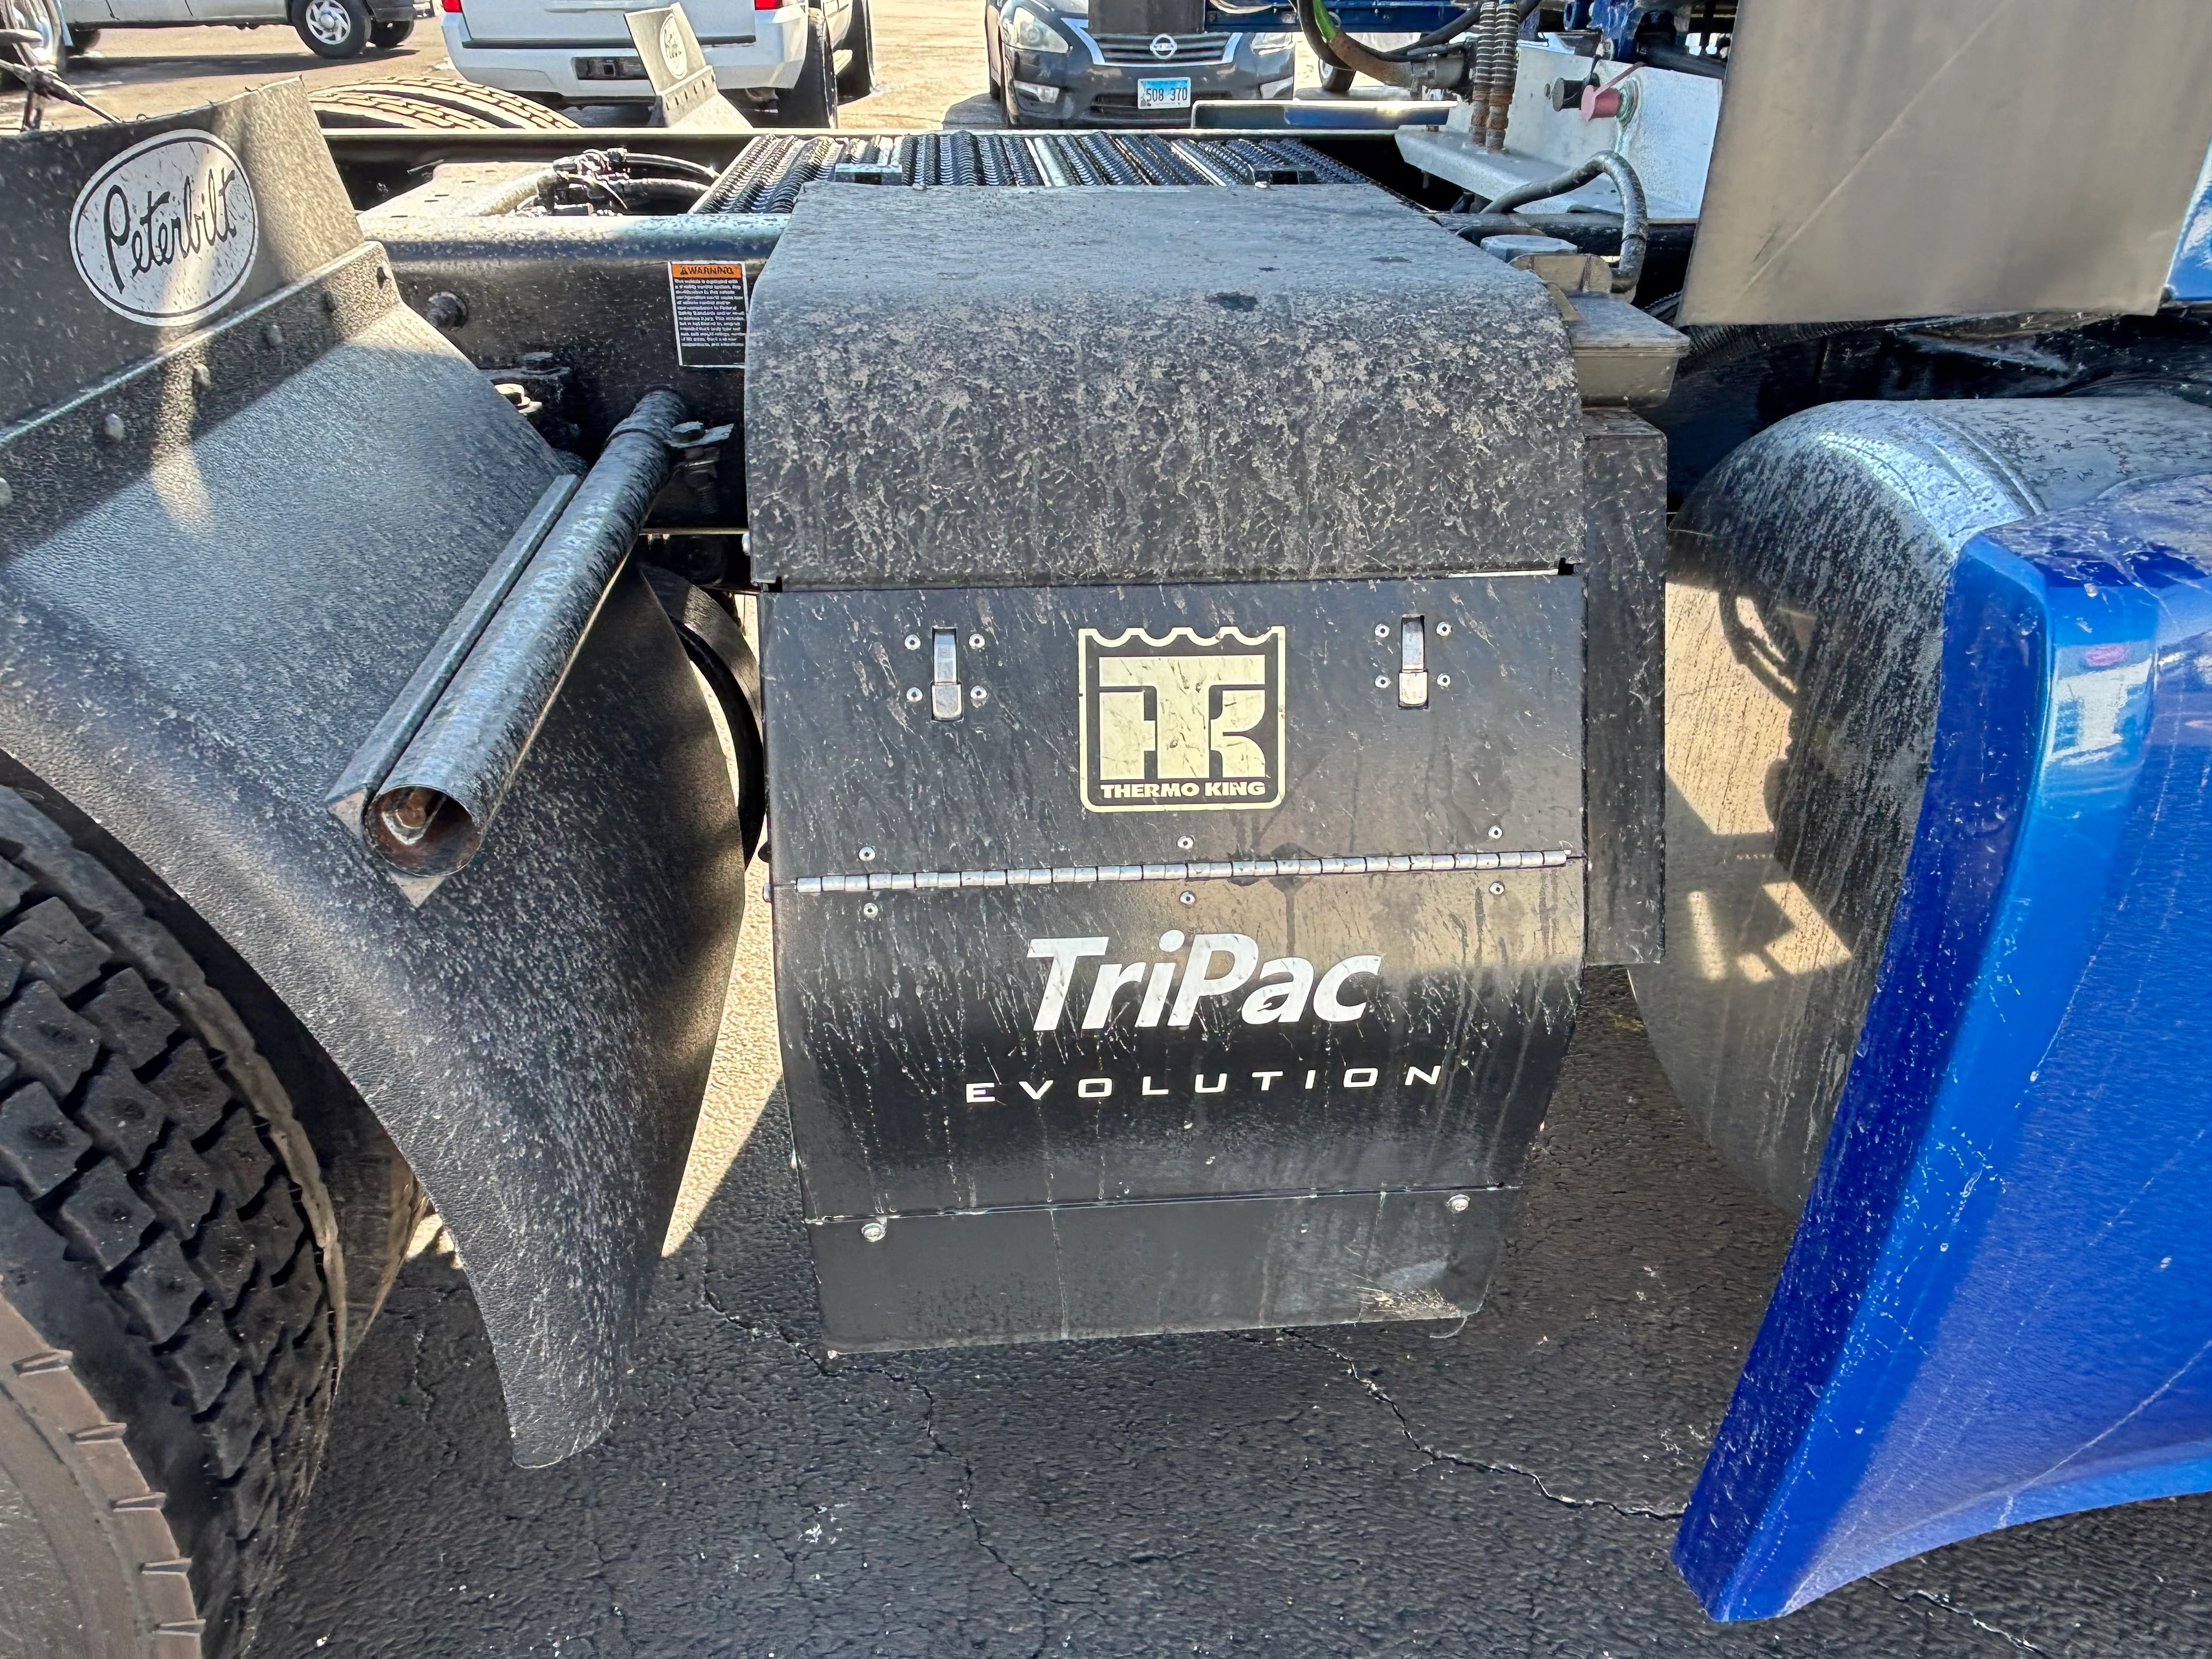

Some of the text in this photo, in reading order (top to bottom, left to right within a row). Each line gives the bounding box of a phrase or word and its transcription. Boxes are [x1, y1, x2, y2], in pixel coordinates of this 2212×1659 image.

[1146, 87, 1188, 102] 508 370
[103, 166, 237, 295] Peterbilt
[688, 266, 735, 275] WARNING
[1100, 781, 1266, 799] THERMO KING
[1026, 929, 1382, 1031] TriPac
[966, 1065, 1442, 1103] EVOLUTION
